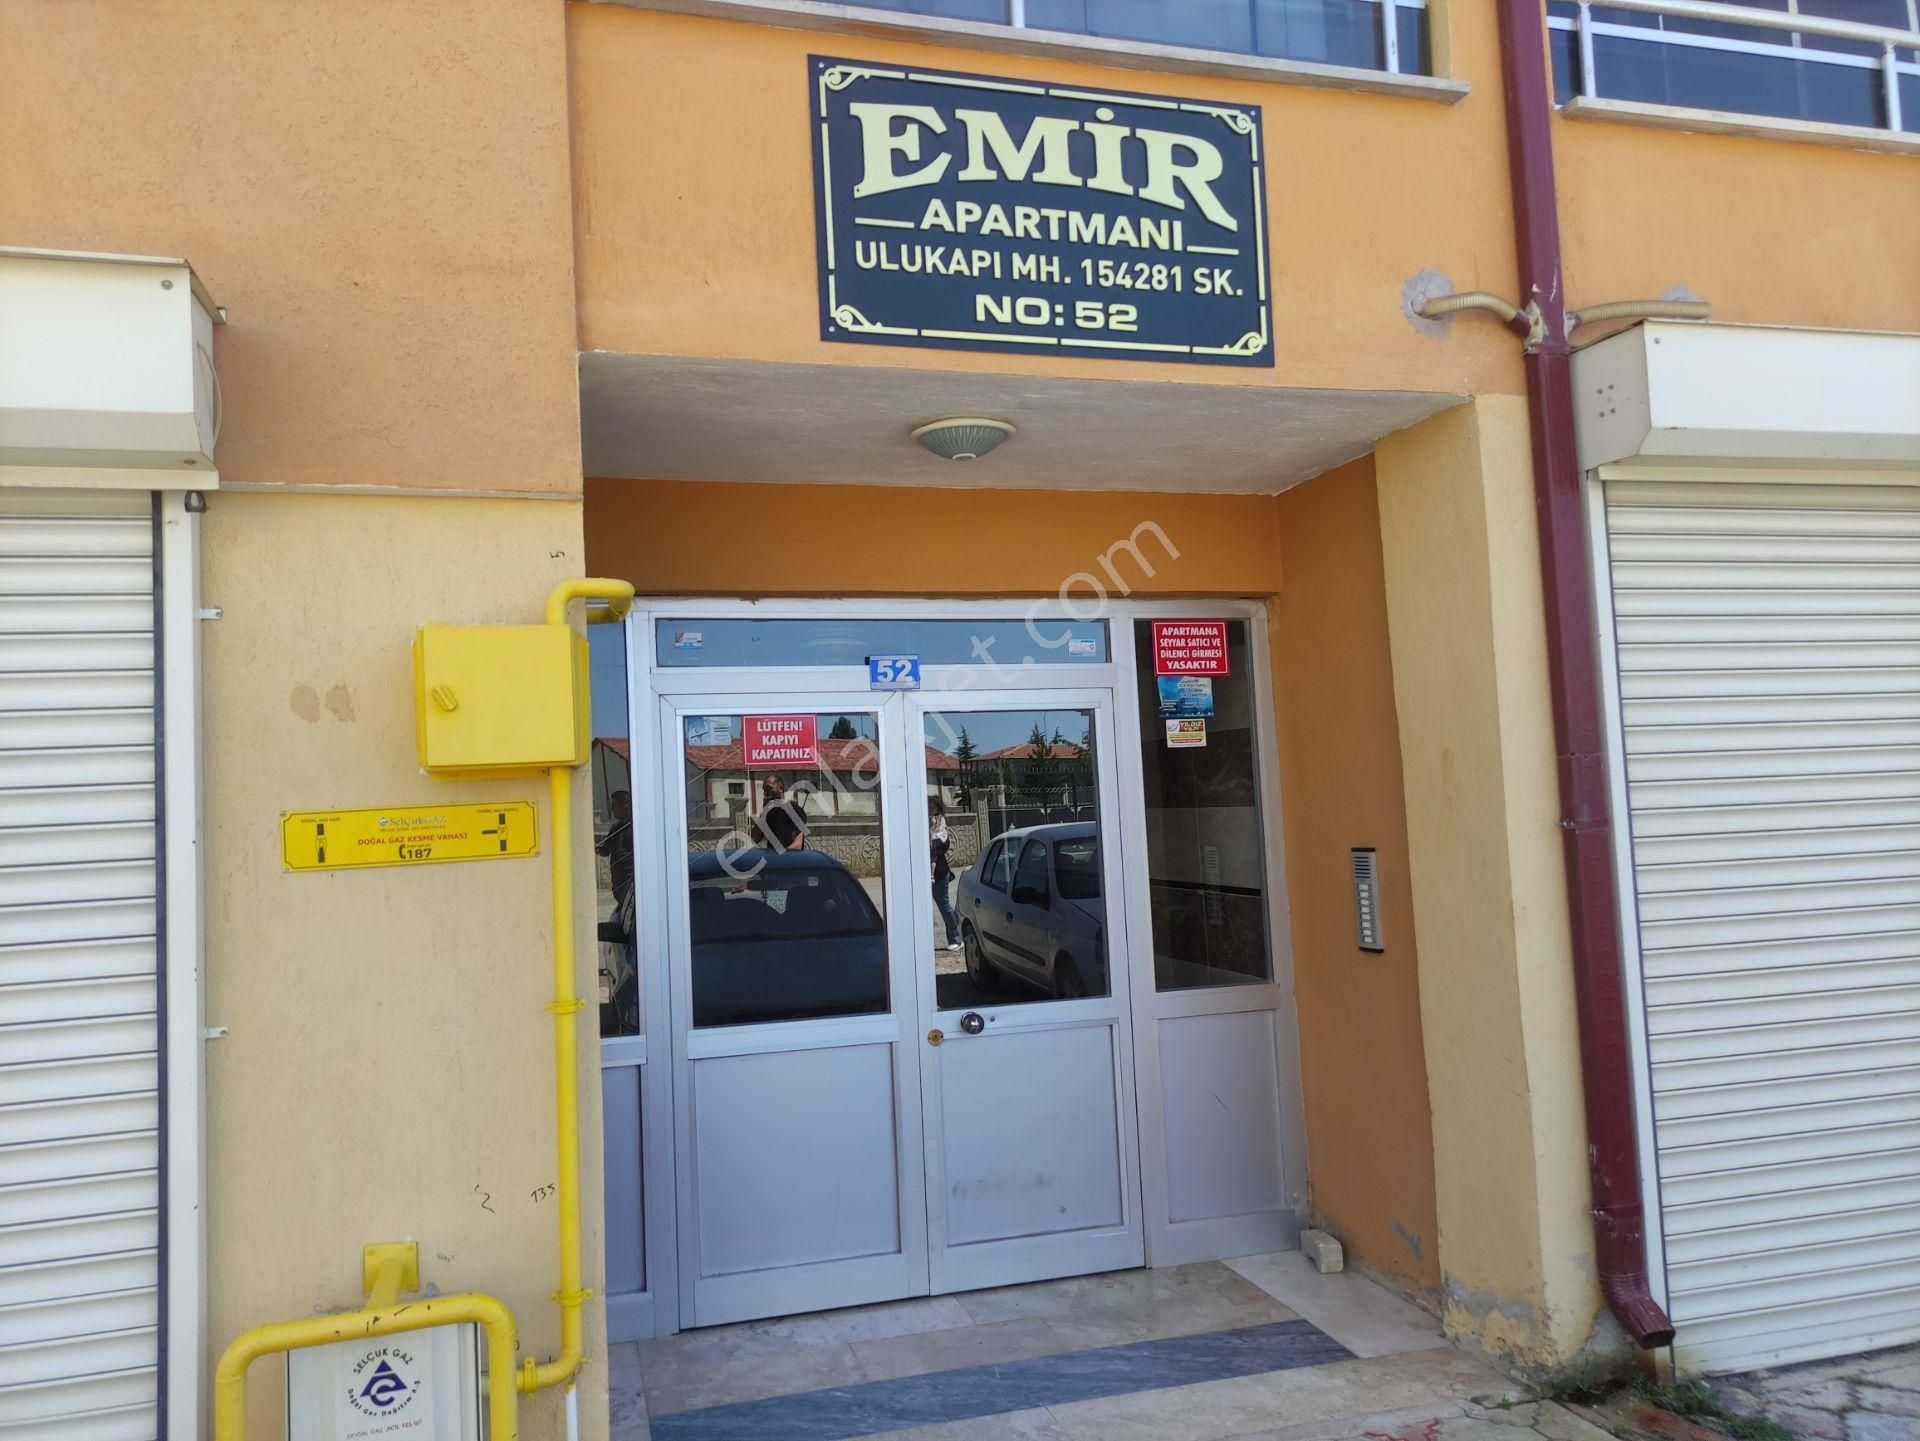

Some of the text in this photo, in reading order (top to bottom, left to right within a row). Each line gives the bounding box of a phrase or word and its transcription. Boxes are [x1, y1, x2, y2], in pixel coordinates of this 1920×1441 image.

[849, 101, 1238, 232] EMİR
[919, 198, 1183, 251] APARTMANI
[855, 241, 1244, 297] ULUKAPI MH. 154281 SK.
[1162, 627, 1219, 636] APARTMANA
[1160, 638, 1222, 648] SEYYAR SATICI VE
[1160, 647, 1222, 659] DİLENCİ GİRMESİ
[877, 659, 913, 682] 52
[1166, 660, 1218, 670] YASAKTIR
[756, 718, 803, 733] LÜTFEN!
[762, 733, 799, 746] KAPIYI
[752, 747, 811, 761] KAPATINIZ
[357, 832, 469, 846] DOĞAL GAZ KESME VANASI
[406, 848, 432, 859] 187
[353, 1347, 414, 1375] SELÇUK GAZ
